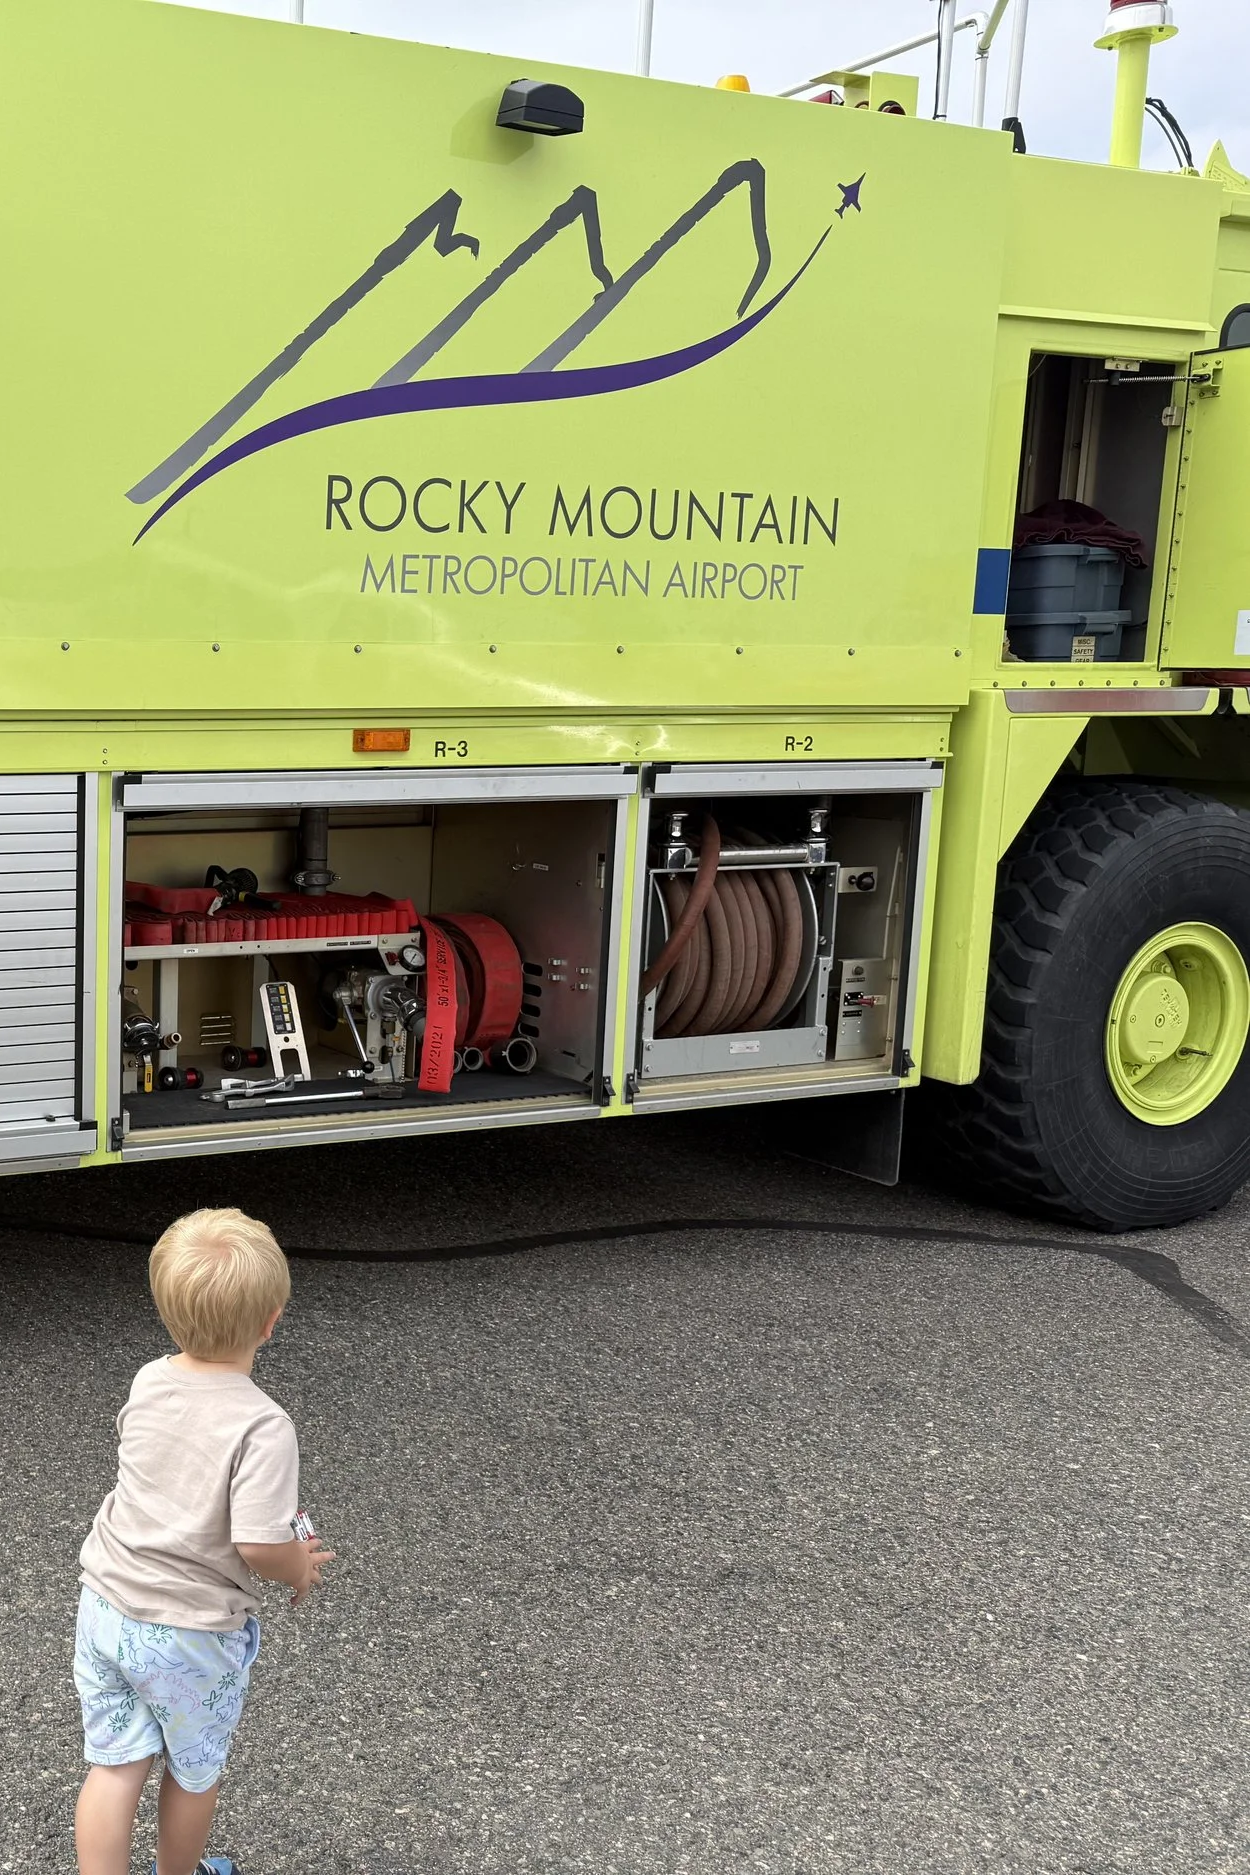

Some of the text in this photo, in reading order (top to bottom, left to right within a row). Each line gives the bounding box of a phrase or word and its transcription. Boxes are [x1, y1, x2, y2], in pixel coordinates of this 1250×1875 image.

[325, 474, 839, 547] ROCKY MOUNTAIN
[359, 553, 805, 601] METROPOLITAN AIRPORT
[434, 740, 468, 758] R-3
[784, 735, 813, 752] R-2
